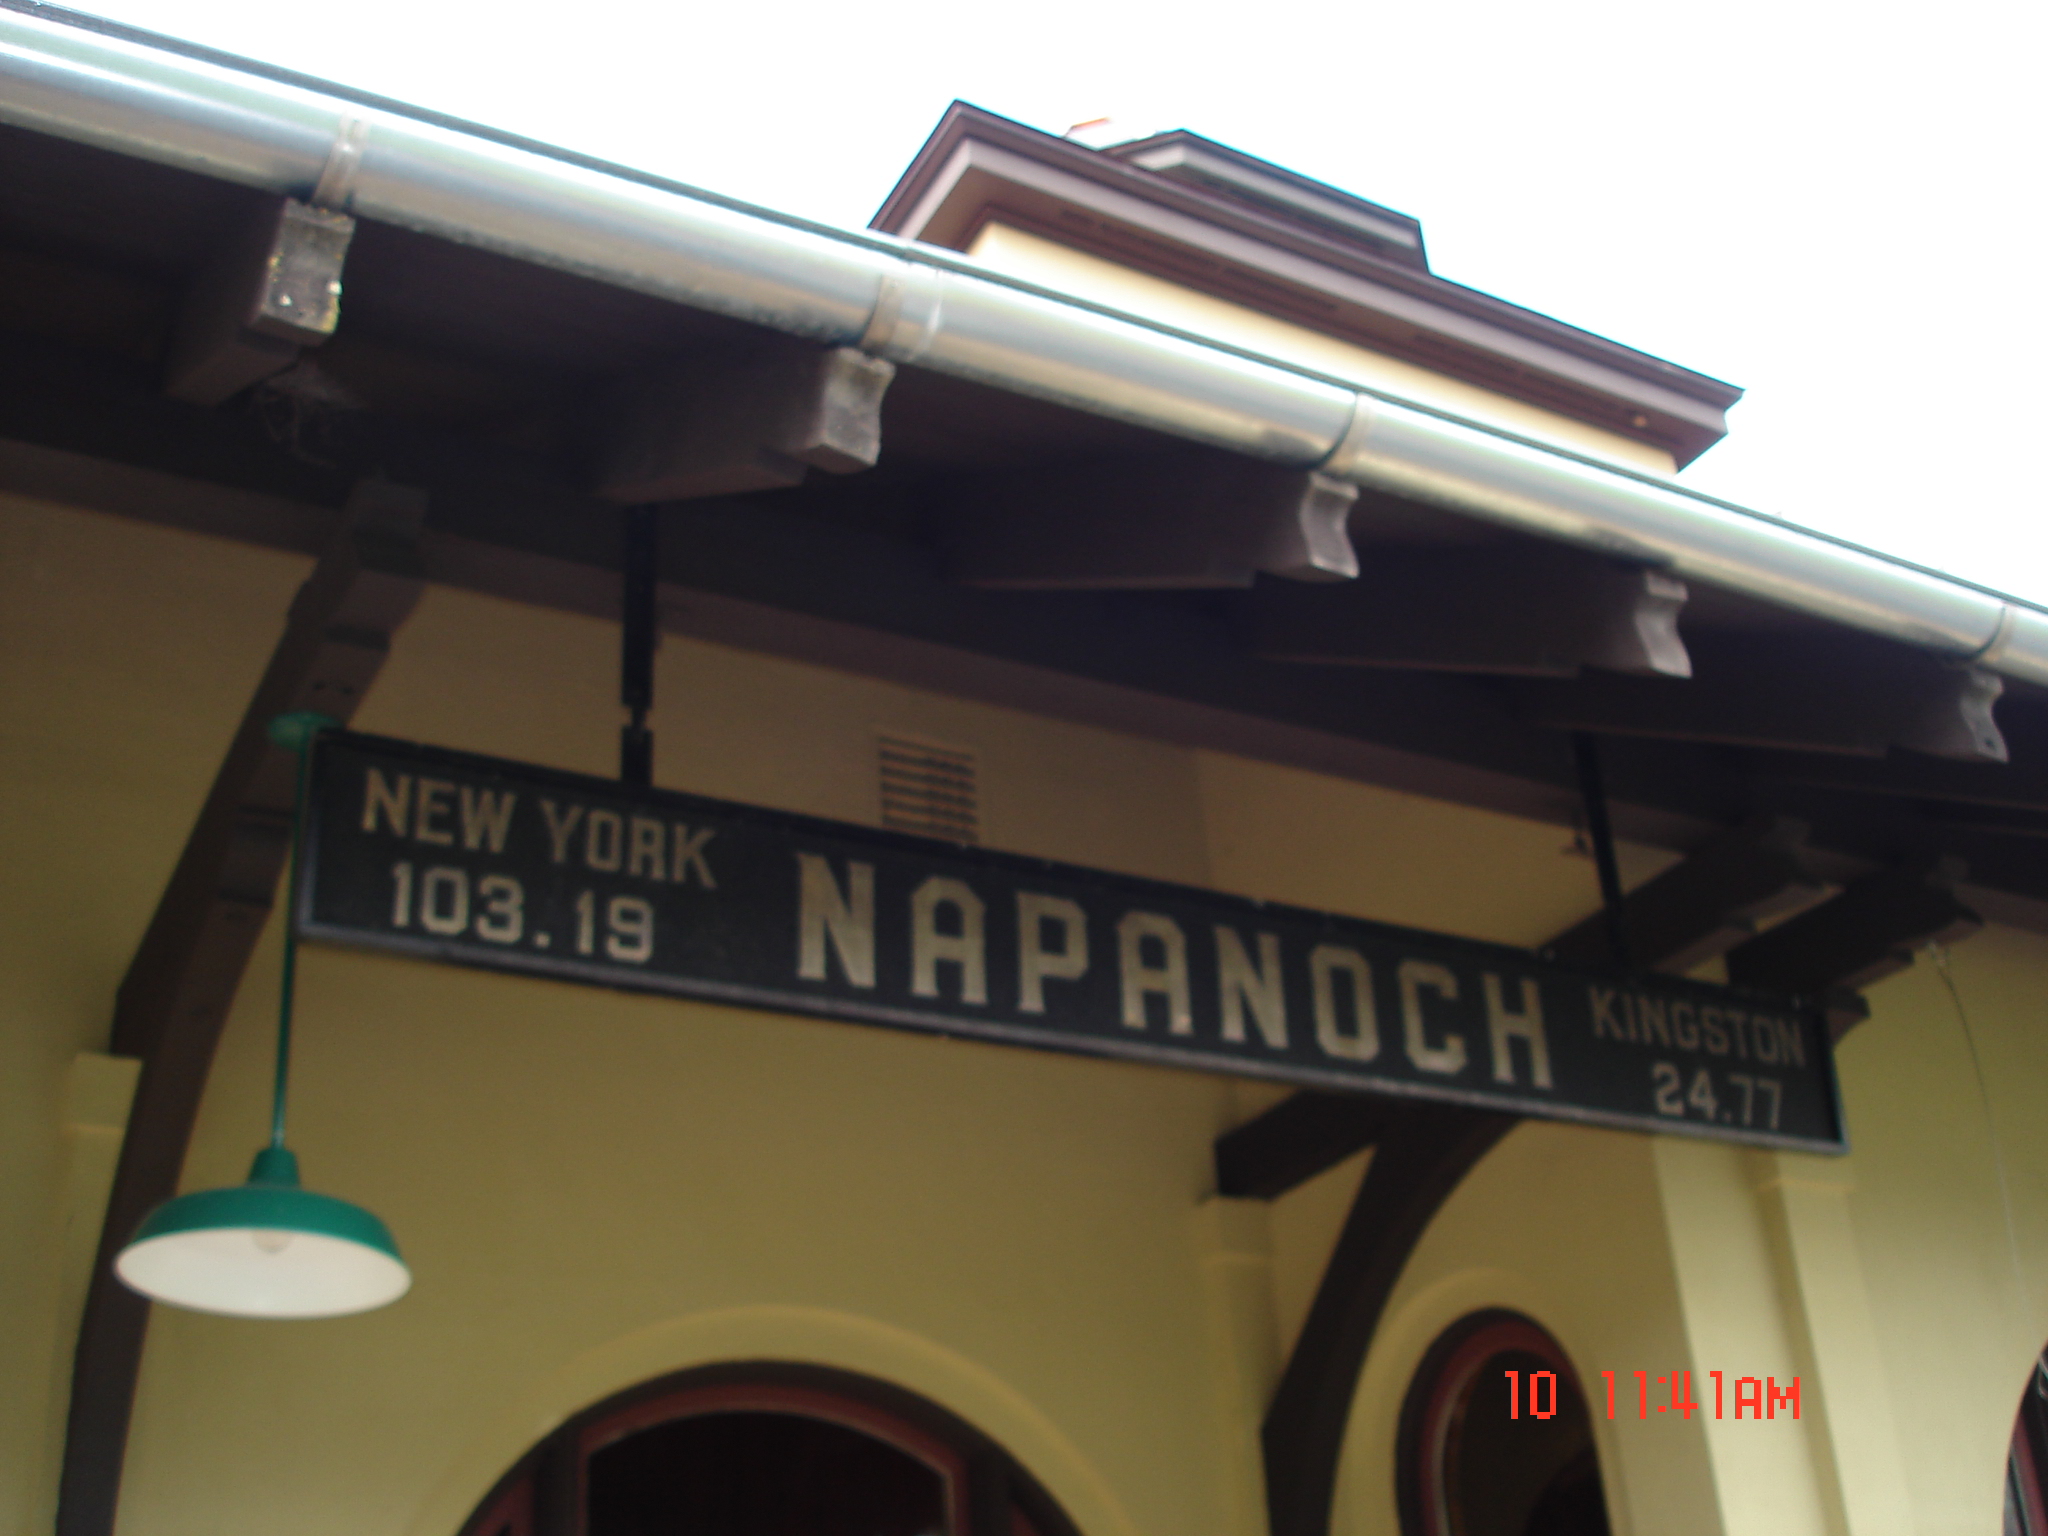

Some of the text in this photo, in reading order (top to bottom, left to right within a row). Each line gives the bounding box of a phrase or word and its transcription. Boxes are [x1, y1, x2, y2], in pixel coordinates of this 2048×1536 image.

[361, 767, 717, 889] NEW YORK
[797, 852, 1553, 1089] NAPANOCH
[1590, 986, 1806, 1067] KINGSTON
[1652, 1061, 1783, 1130] 24.77
